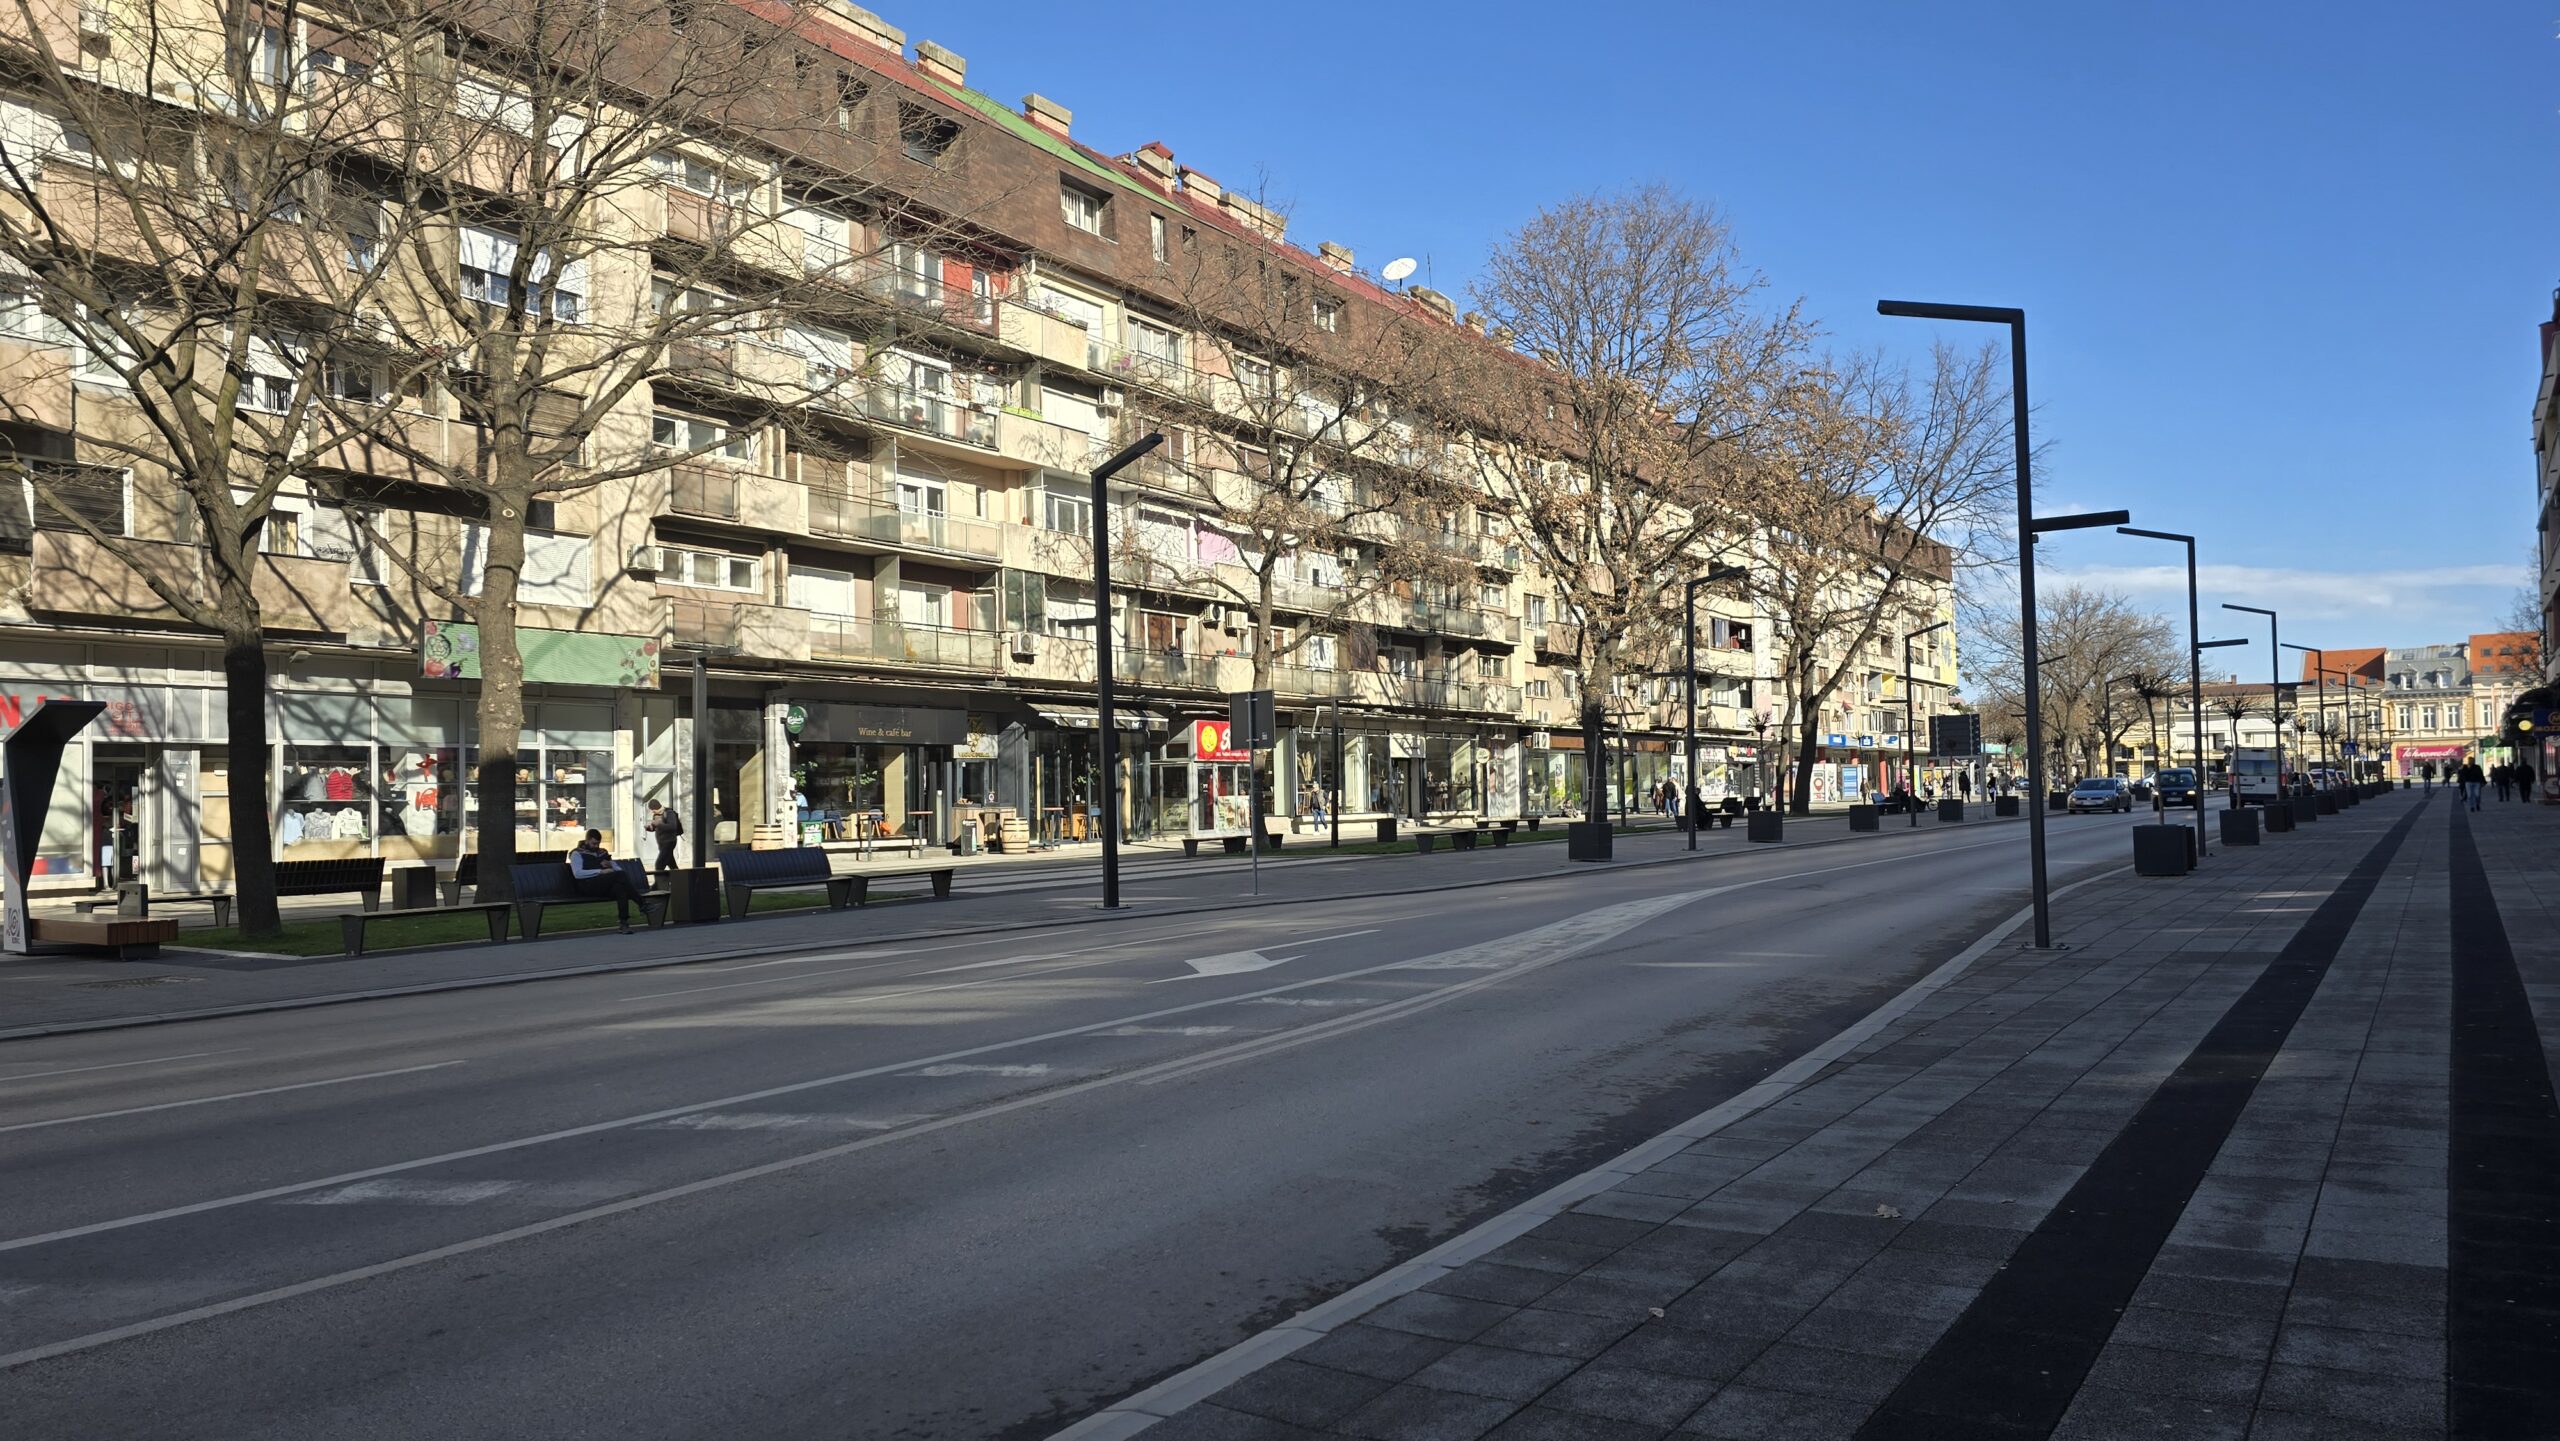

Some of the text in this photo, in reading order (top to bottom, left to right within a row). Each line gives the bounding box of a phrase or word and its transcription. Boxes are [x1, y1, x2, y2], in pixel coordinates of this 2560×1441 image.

[858, 727, 877, 736] Wine
[877, 728, 885, 737] &
[900, 728, 912, 738] bar
